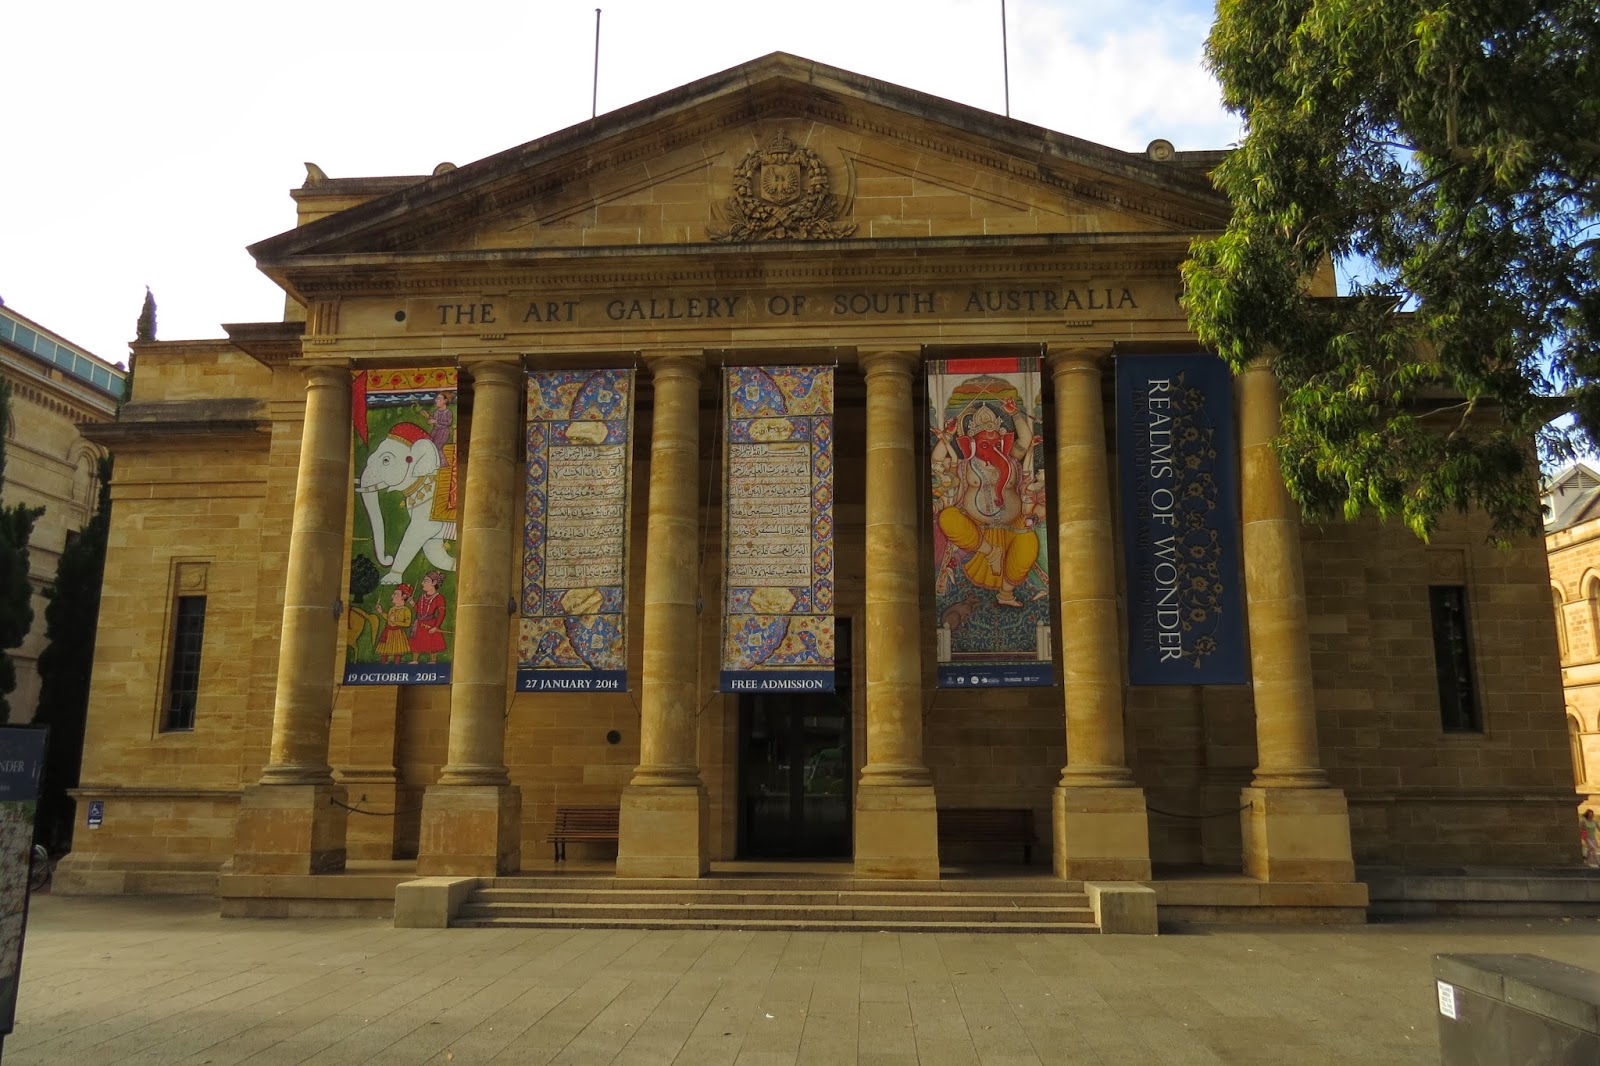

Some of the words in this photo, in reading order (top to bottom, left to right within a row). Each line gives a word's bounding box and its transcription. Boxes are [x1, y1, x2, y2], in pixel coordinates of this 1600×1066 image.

[438, 302, 496, 325] THE
[522, 301, 580, 323] ART
[606, 296, 740, 320] GALLERY
[767, 295, 806, 316] OF
[833, 292, 935, 315] SOUTH
[963, 288, 1139, 313] AUSTRALIA
[1148, 378, 1173, 479] REALMS
[1151, 488, 1175, 525] OF
[1153, 535, 1183, 663] WONDER
[348, 673, 358, 682] 19
[360, 673, 409, 682] OCTOBER
[415, 672, 437, 681] 2013
[525, 680, 538, 689] 27
[539, 680, 592, 690] JANUARY
[595, 680, 619, 689] 2014
[731, 680, 757, 689] FREE
[761, 680, 823, 689] ADMISSION
